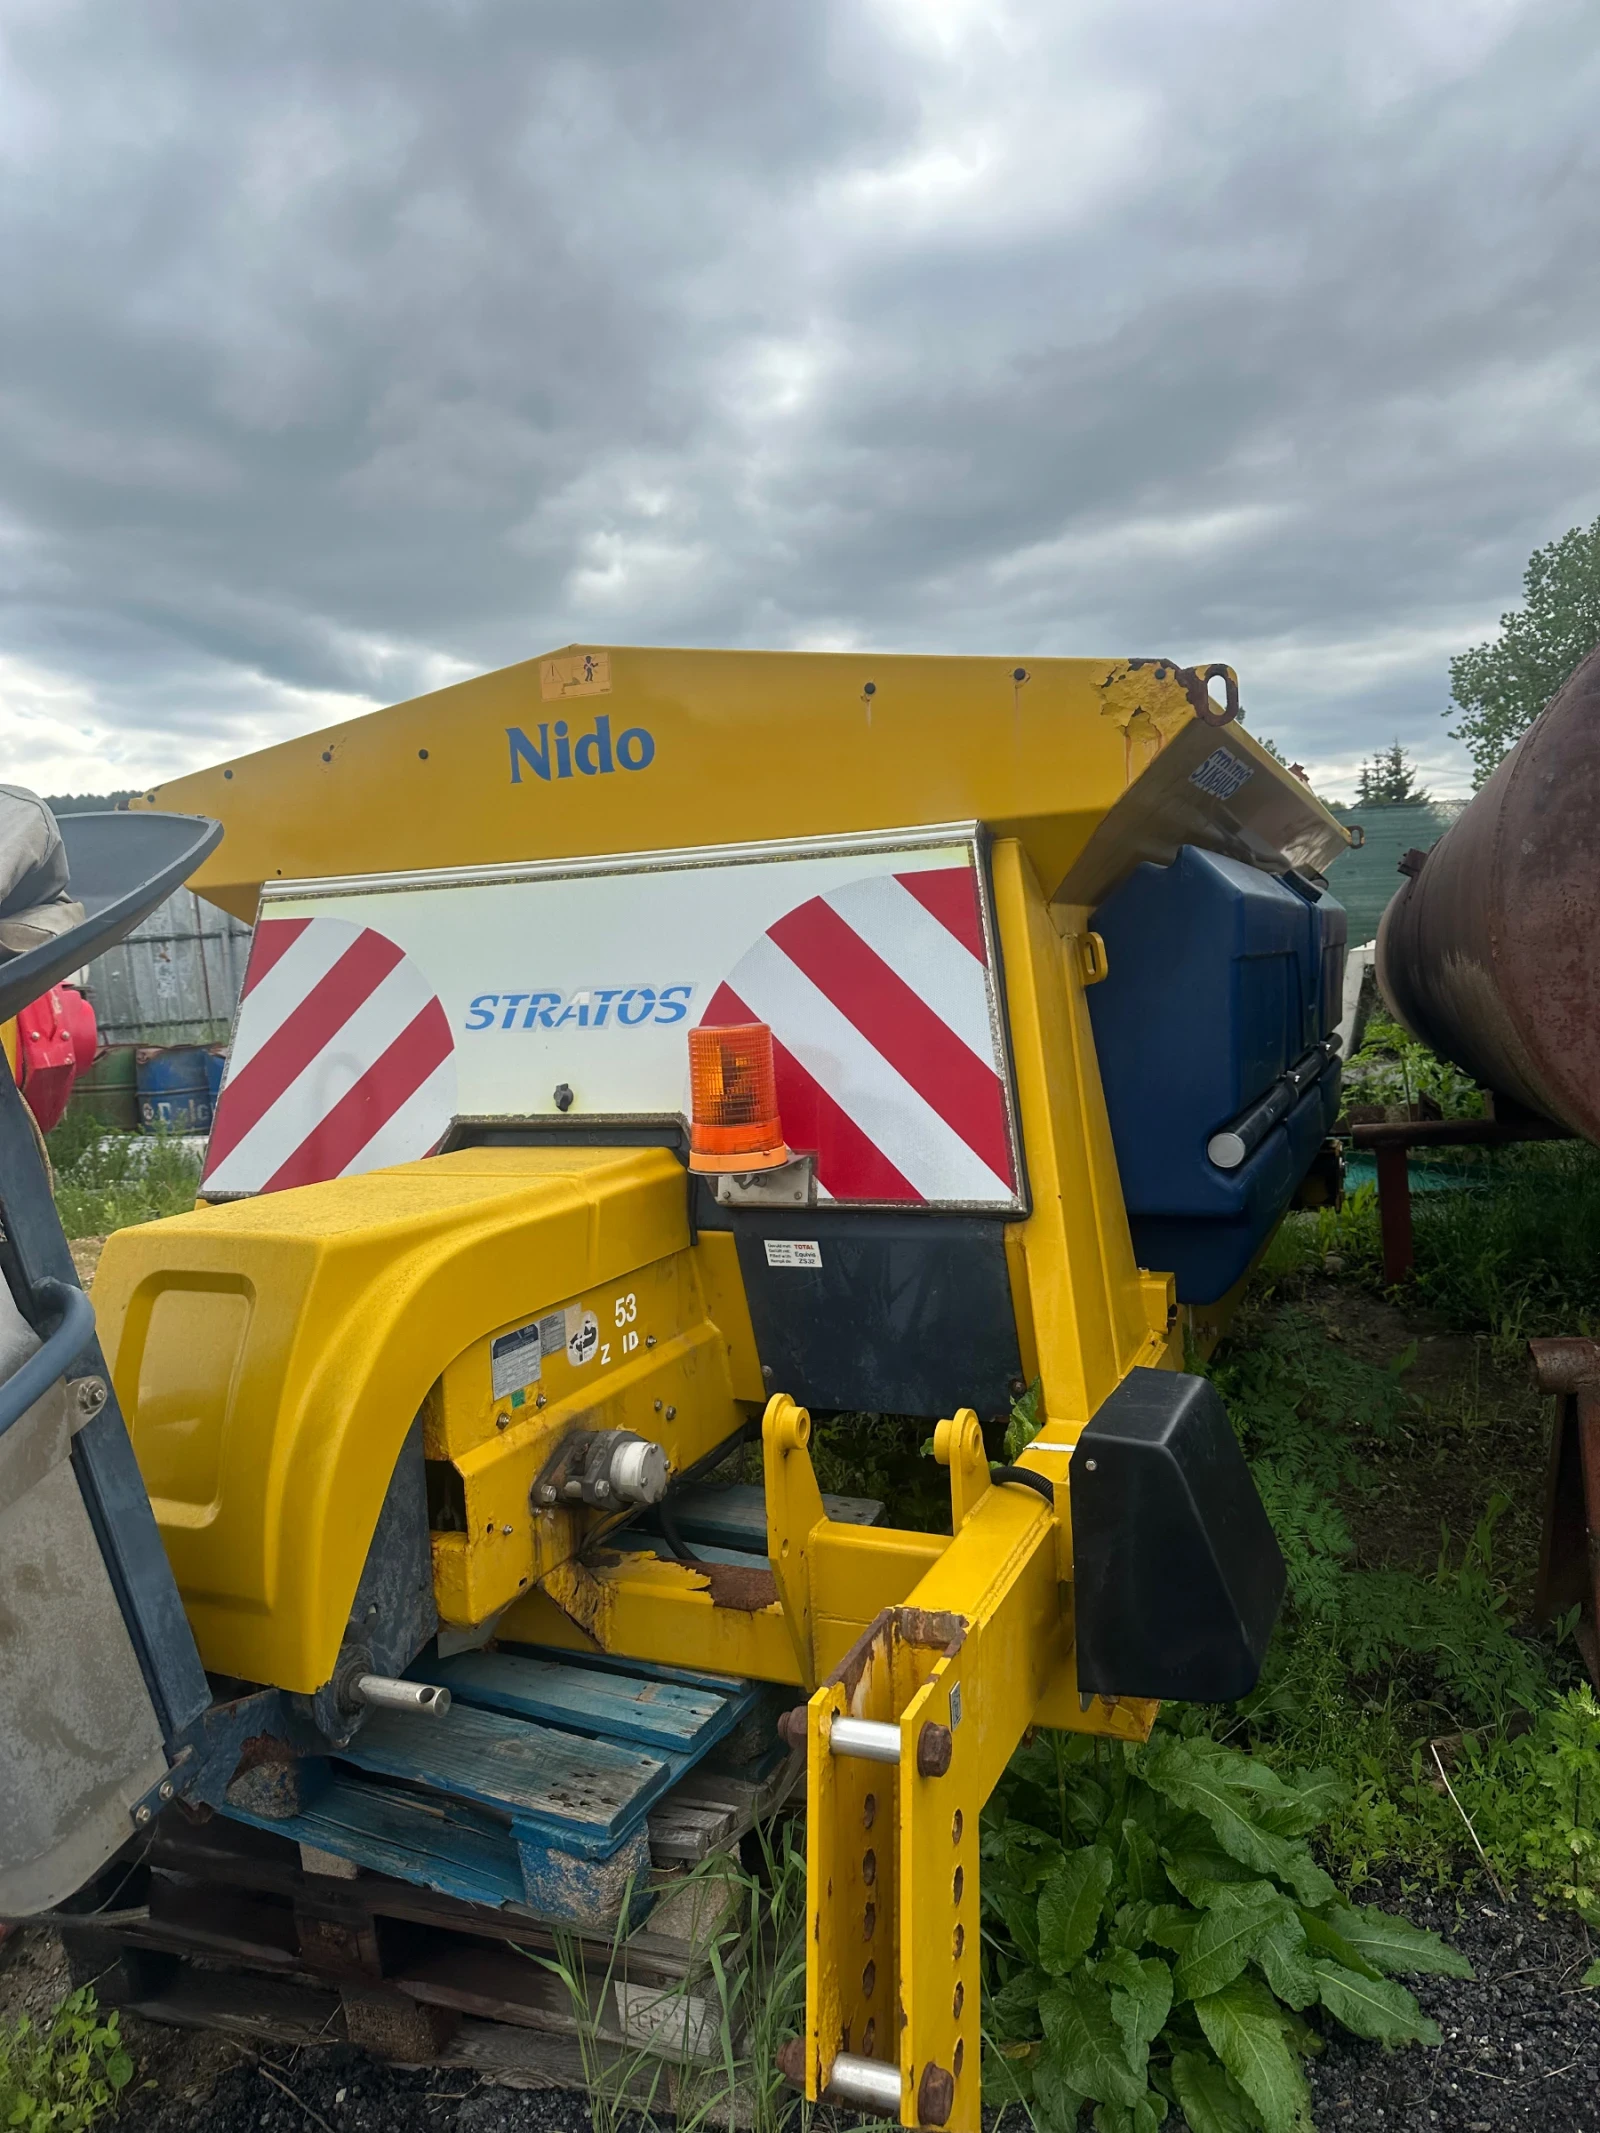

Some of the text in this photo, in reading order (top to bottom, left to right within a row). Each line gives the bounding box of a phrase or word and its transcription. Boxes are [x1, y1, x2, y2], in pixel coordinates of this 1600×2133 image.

[505, 714, 656, 783] Nido
[465, 986, 693, 1030] STRATOS
[615, 1293, 637, 1328] 53
[600, 1331, 639, 1365] Z ID
